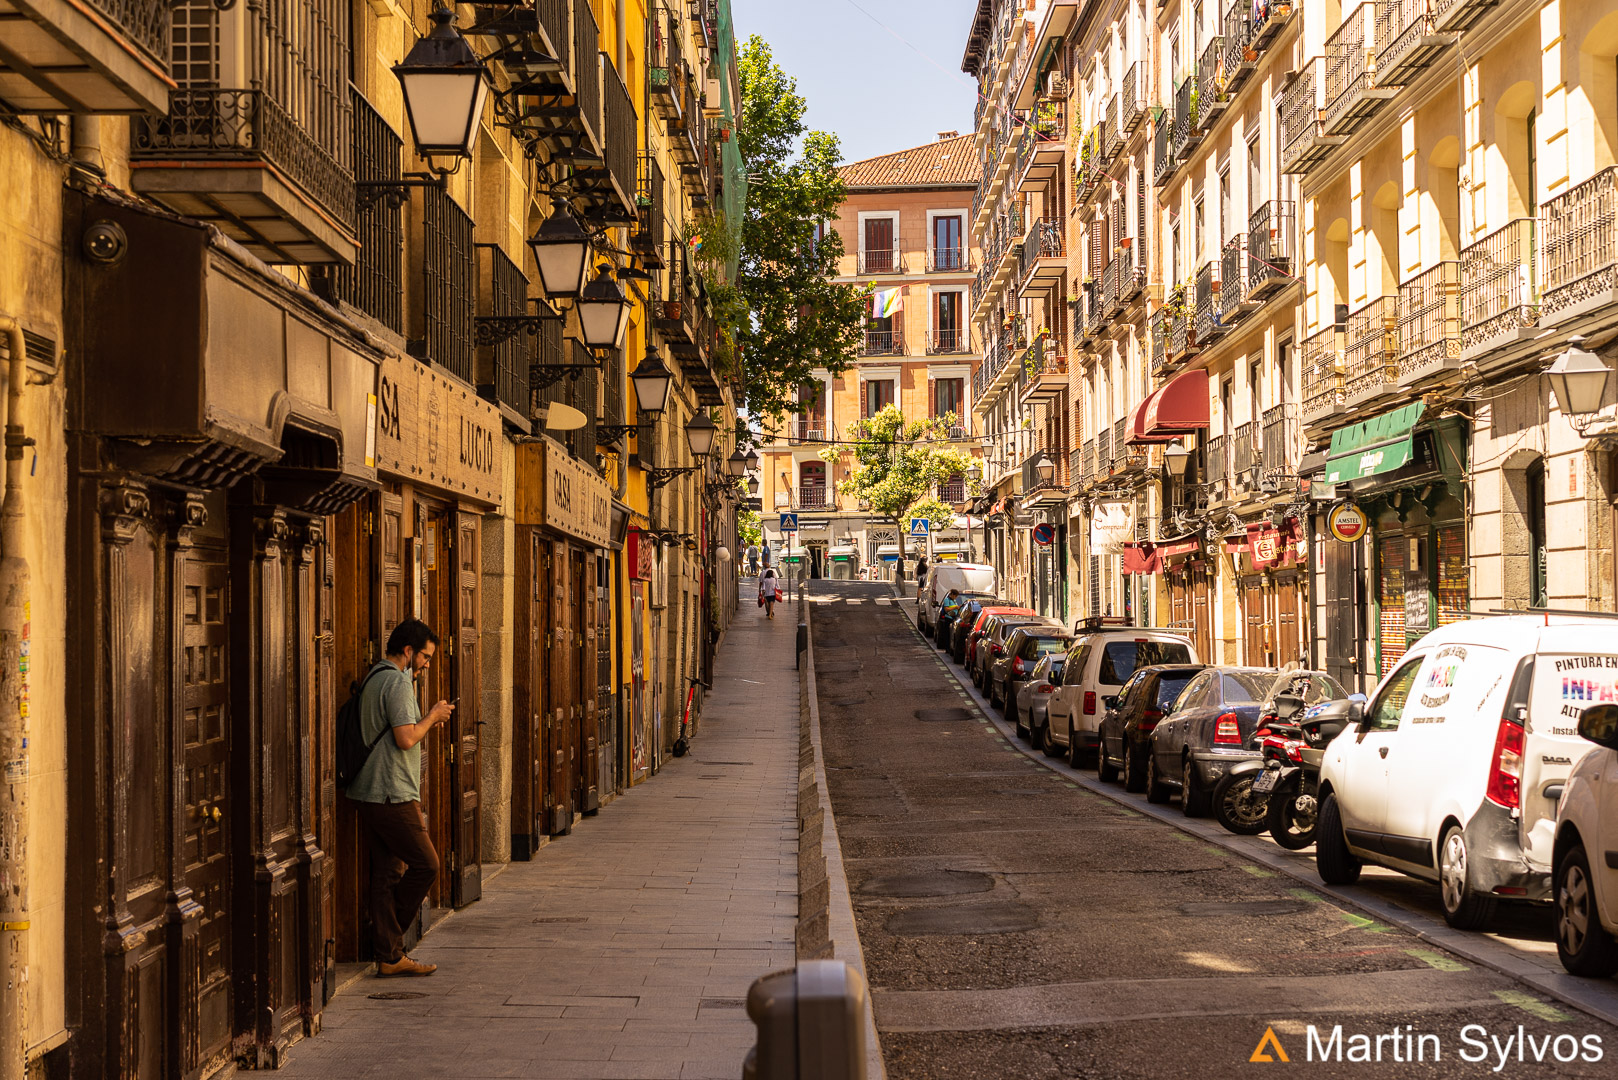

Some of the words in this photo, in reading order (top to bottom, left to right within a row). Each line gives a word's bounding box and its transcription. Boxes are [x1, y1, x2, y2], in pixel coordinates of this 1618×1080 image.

[460, 415, 493, 475] LUCIO
[554, 468, 571, 513] CASA
[1555, 656, 1603, 672] PINTURA
[1561, 704, 1581, 720] ALT
[1552, 726, 1580, 736] Instal
[1541, 755, 1572, 765] DACIA
